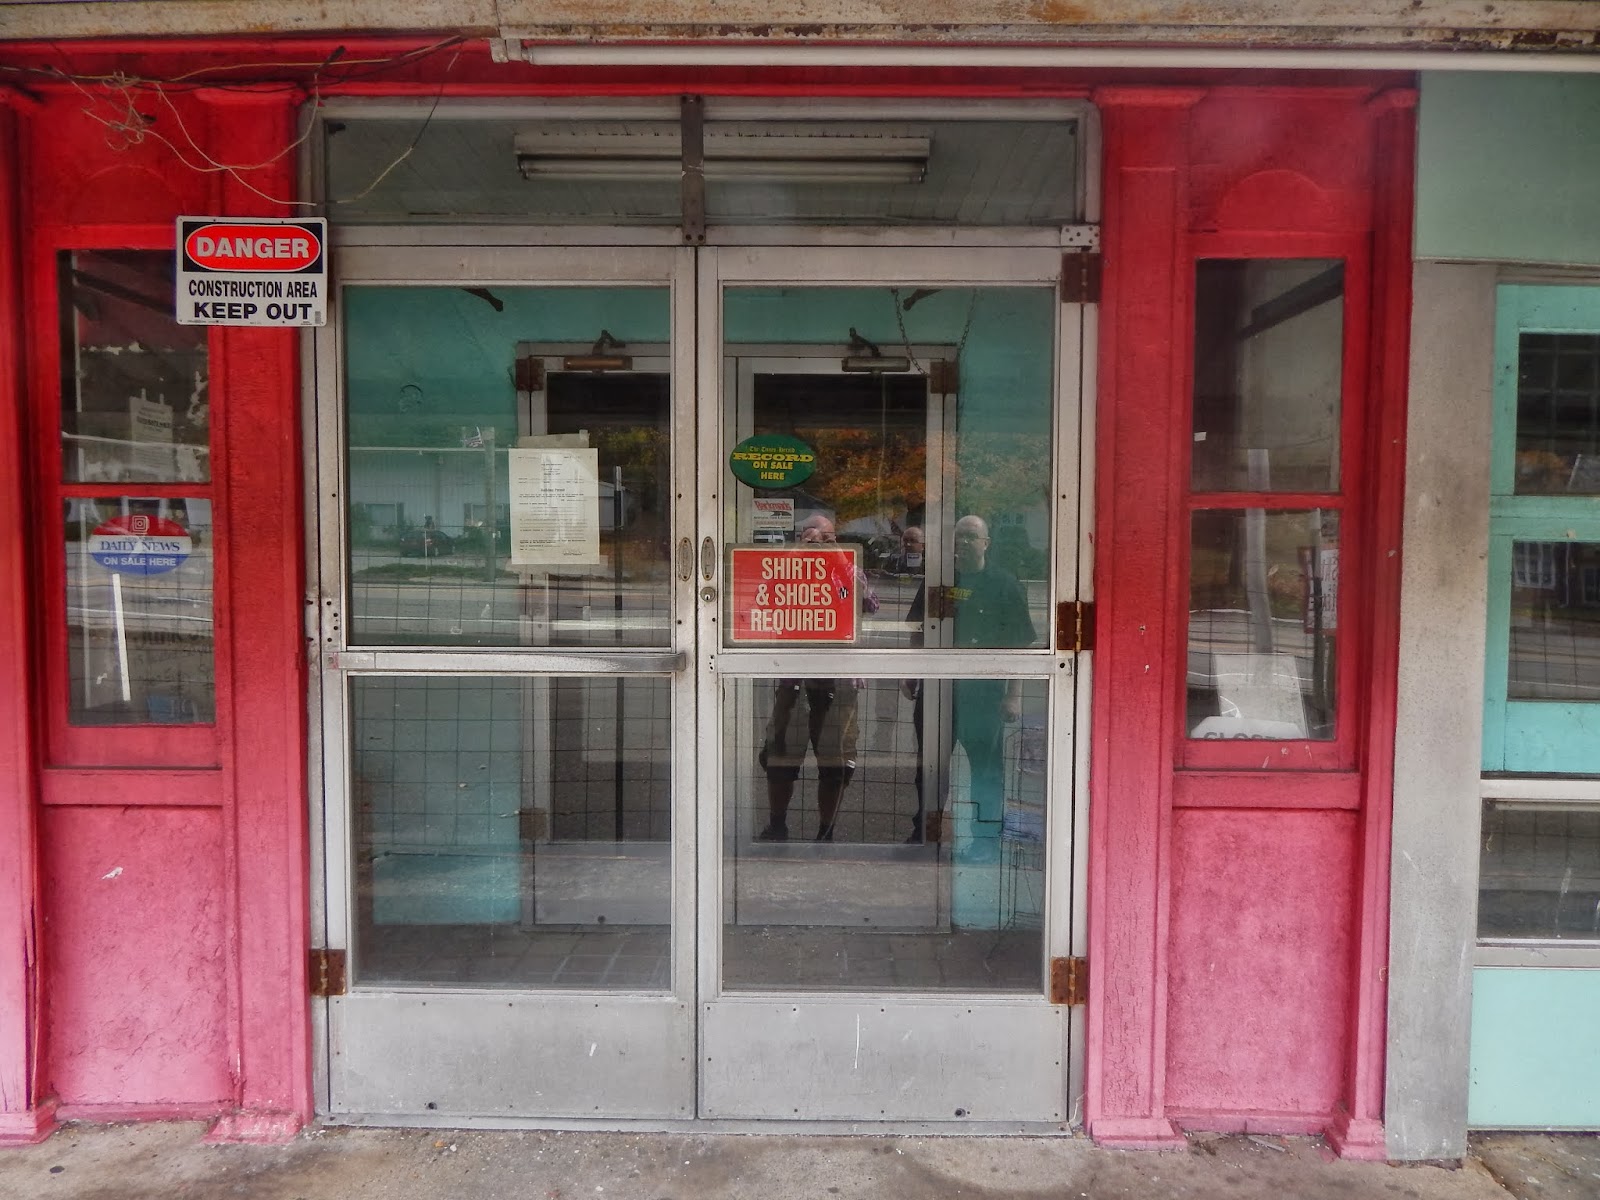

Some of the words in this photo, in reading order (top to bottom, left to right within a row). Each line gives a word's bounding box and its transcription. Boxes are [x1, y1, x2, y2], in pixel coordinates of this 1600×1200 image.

[196, 236, 310, 258] DANGER
[188, 279, 282, 298] CONSTRUCTION
[286, 281, 318, 298] AREA
[194, 302, 258, 319] KEEP
[266, 303, 312, 320] OUT
[733, 453, 814, 462] RECORD
[753, 461, 768, 469] ON
[770, 461, 793, 470] SALE
[760, 472, 785, 480] HERE
[101, 541, 137, 551] DAILY
[141, 541, 180, 551] NEWS
[103, 557, 118, 566] ON
[121, 557, 146, 566] SALE
[149, 558, 176, 566] HERE
[761, 557, 827, 580] SHIRTS
[755, 583, 770, 606] &
[774, 583, 833, 606] SHOES
[750, 608, 837, 635] REQUIRED
